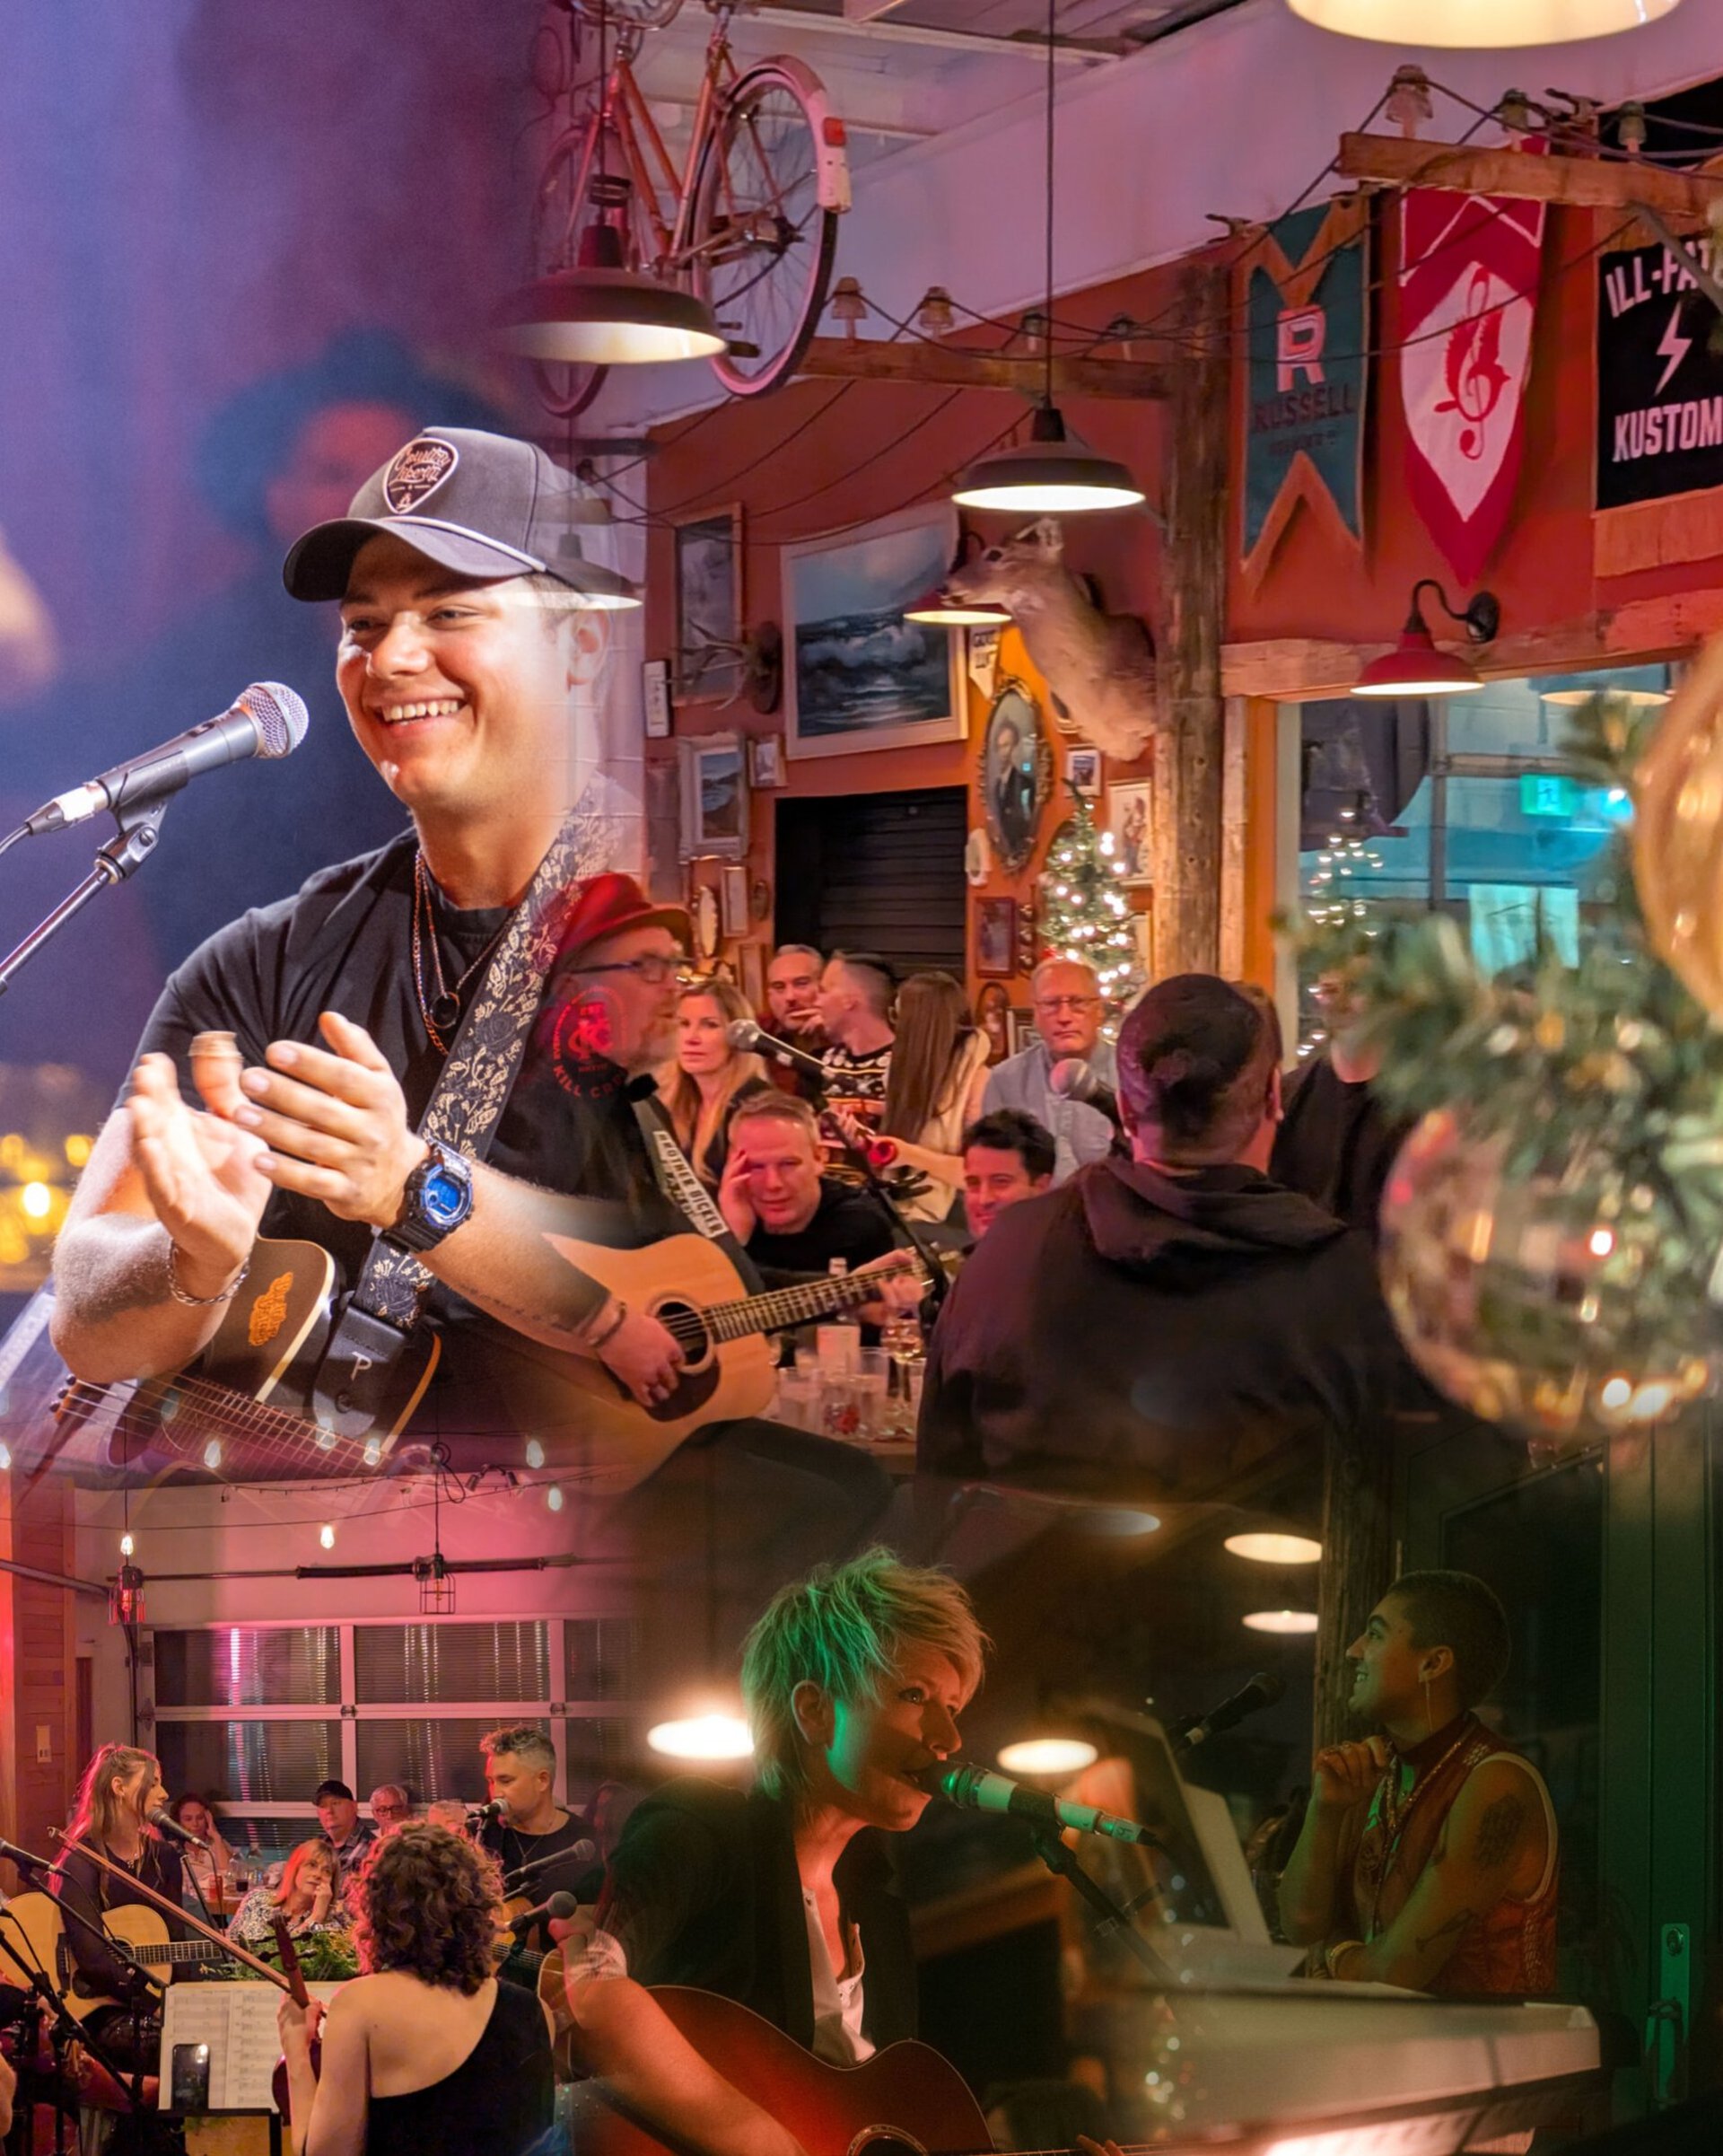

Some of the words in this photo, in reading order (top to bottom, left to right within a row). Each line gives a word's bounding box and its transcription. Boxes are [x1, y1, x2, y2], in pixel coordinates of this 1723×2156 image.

[1277, 305, 1326, 392] R
[1254, 384, 1357, 432] RUSSELL
[1613, 395, 1722, 462] KUSTOM
[553, 1065, 582, 1098] KILL
